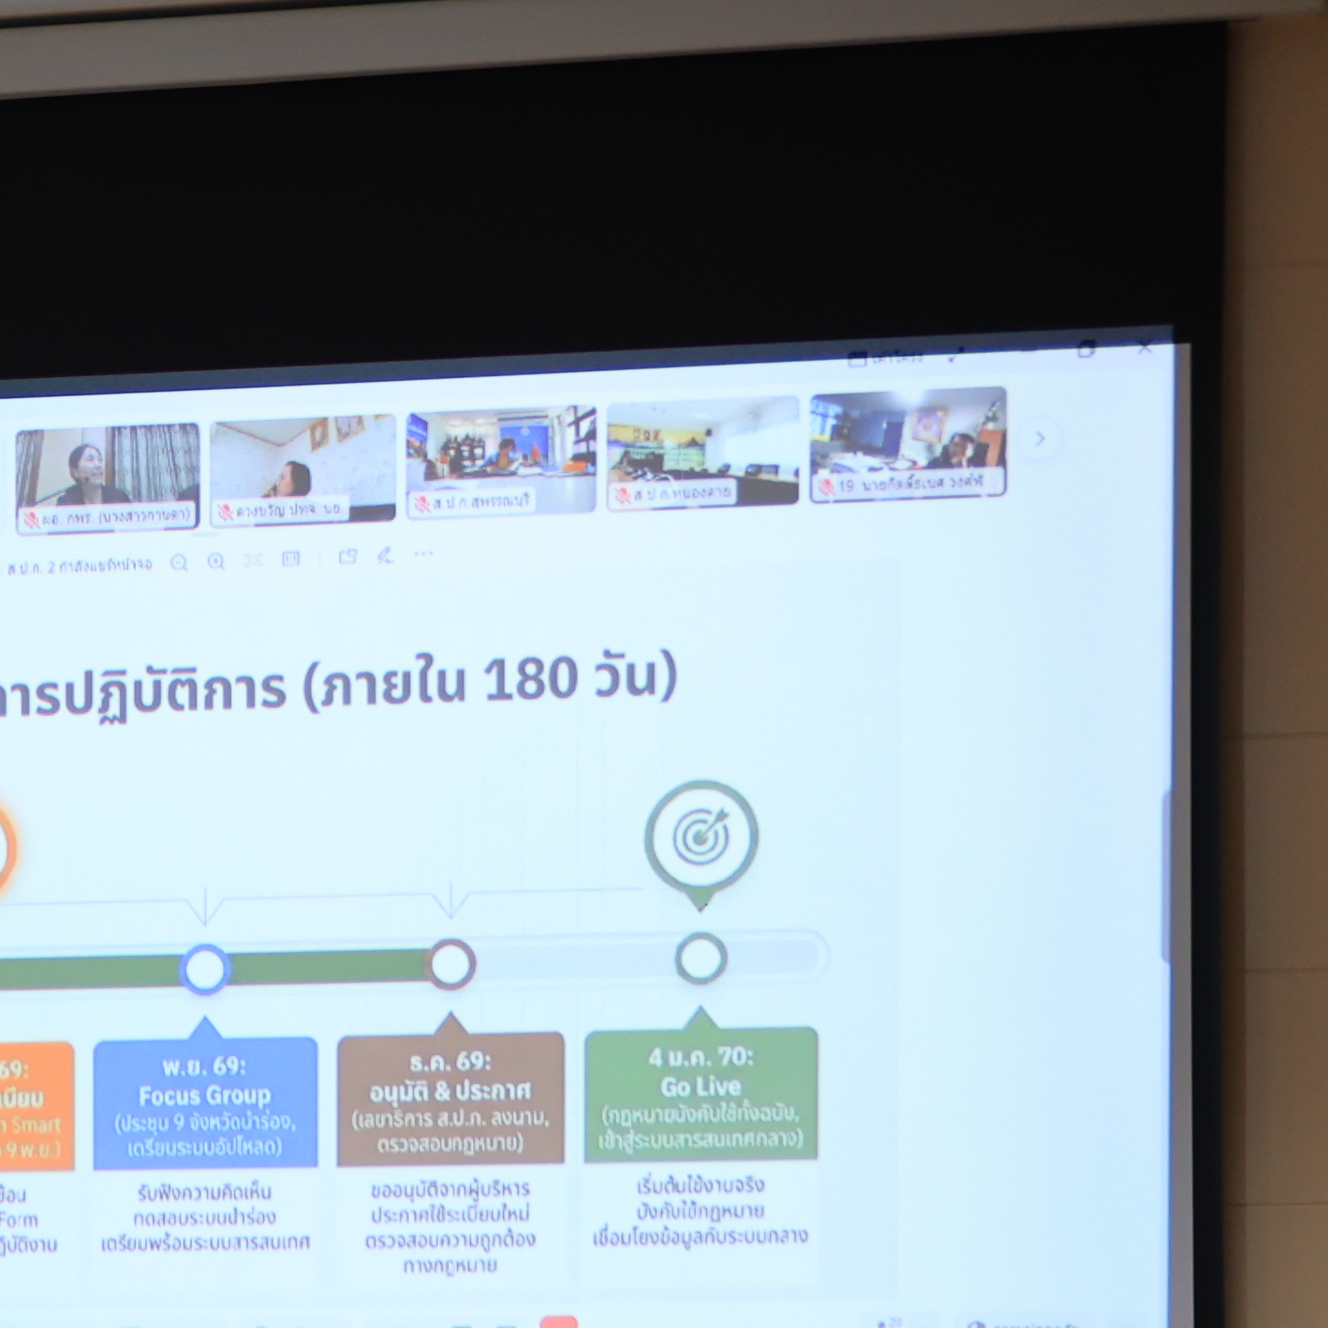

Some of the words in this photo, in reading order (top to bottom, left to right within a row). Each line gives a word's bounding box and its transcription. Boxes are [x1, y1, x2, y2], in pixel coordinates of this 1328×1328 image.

[47, 561, 55, 575] 2
[302, 652, 467, 715] (ภายใน
[483, 658, 580, 704] 180
[594, 648, 679, 704] วัน)
[162, 1057, 207, 1077] พ.ย.
[212, 1056, 246, 1076] 69:
[456, 1050, 492, 1071] 69:
[648, 1048, 662, 1067] 4
[718, 1046, 755, 1066] 70:
[138, 1085, 201, 1106] Focus
[205, 1084, 272, 1110] Group
[369, 1079, 429, 1108] อนุมัติ
[434, 1083, 450, 1101] &
[456, 1079, 532, 1102] ประกาศ
[660, 1078, 691, 1098] Go
[696, 1077, 742, 1098] Live
[12, 1115, 62, 1134] Smart
[174, 1113, 185, 1129] 9
[6, 1142, 18, 1158] 9
[137, 1178, 272, 1203] รับฟังความคิดเห็น
[370, 1178, 531, 1205] ขออนุมัติจากผู้บริหาร
[636, 1171, 766, 1195] เริ่มต้นใช้งานจริง
[132, 1205, 277, 1228] ทดสอบระบบนำร่อง
[100, 1229, 311, 1254] เตรียมพร้อมระบบสารสนเทศ
[364, 1230, 537, 1255] ตรวจสอบความถูกต้อง
[403, 1257, 498, 1277] ทางกฎหมาย
